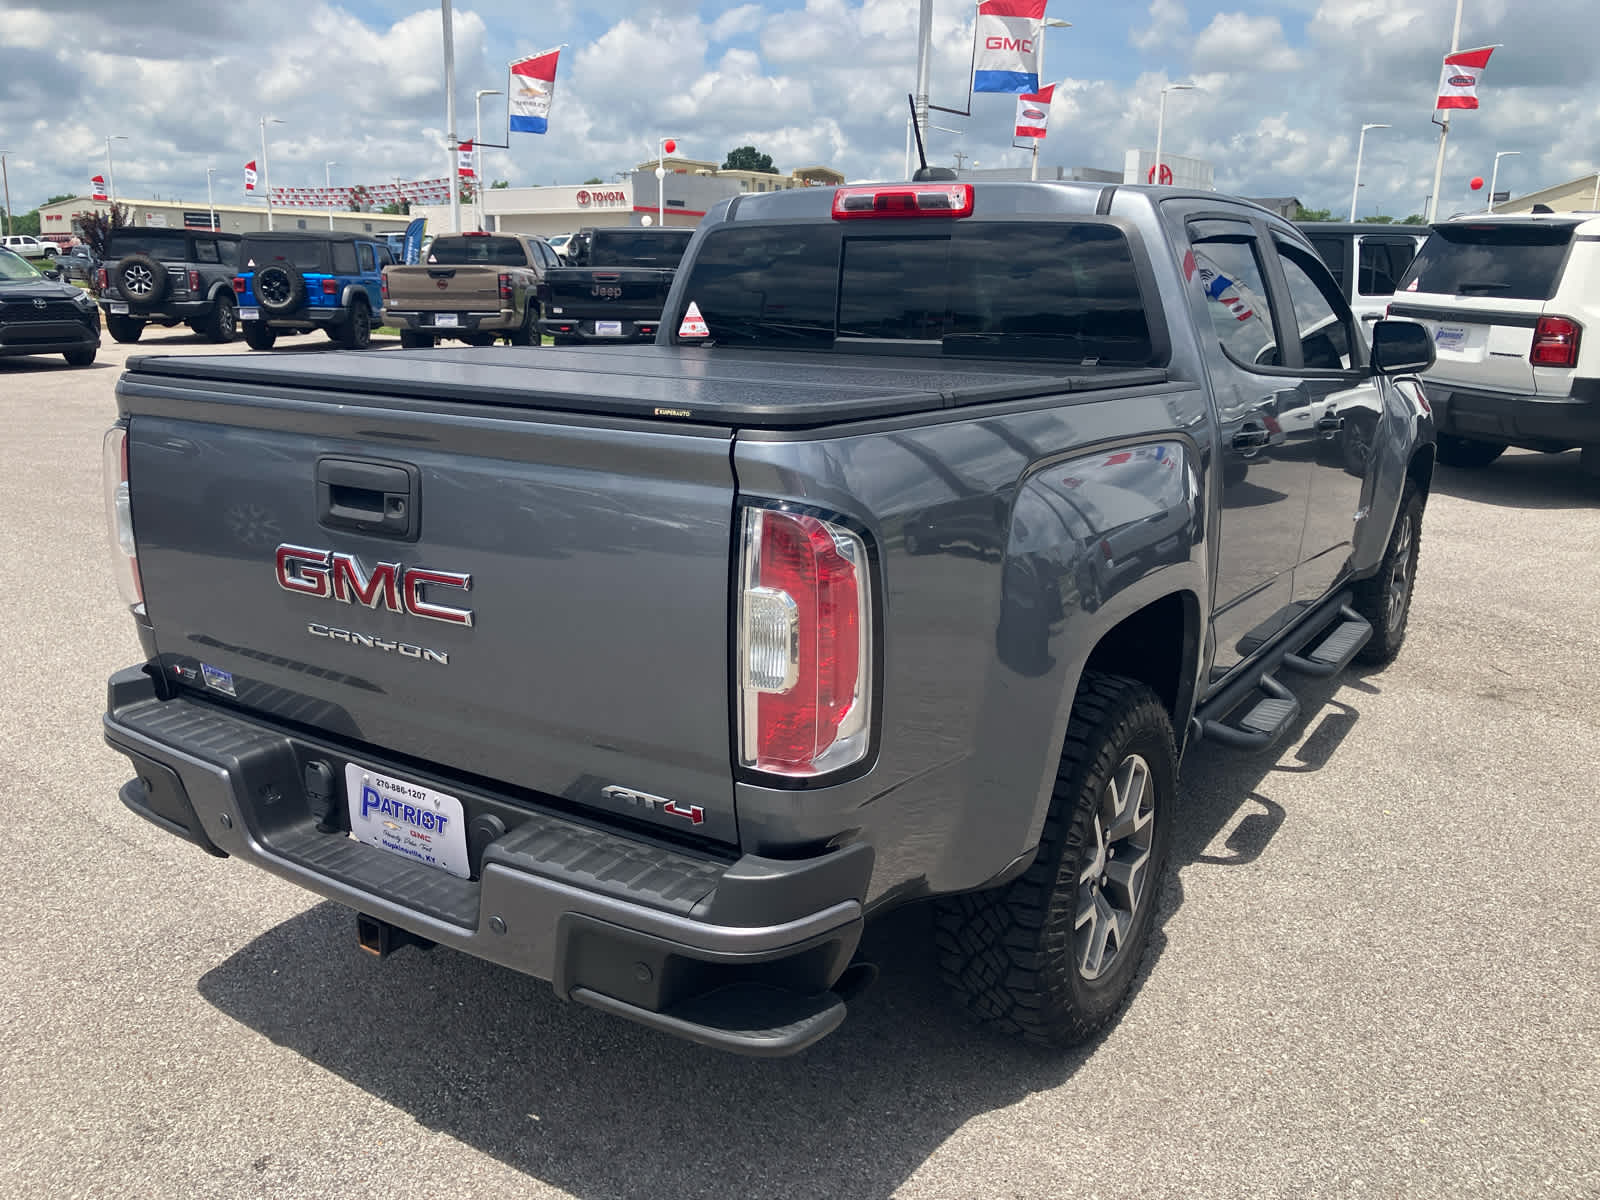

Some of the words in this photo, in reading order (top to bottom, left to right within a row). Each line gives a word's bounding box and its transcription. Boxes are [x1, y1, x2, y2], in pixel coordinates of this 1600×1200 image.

[985, 36, 1032, 53] GMC
[592, 191, 626, 201] TOYOTA
[591, 284, 622, 297] Jeep
[275, 543, 473, 627] GMC
[306, 622, 449, 665] CANYON
[362, 785, 447, 833] PATRIOT
[600, 785, 704, 826] AT4
[410, 829, 432, 842] GMC
